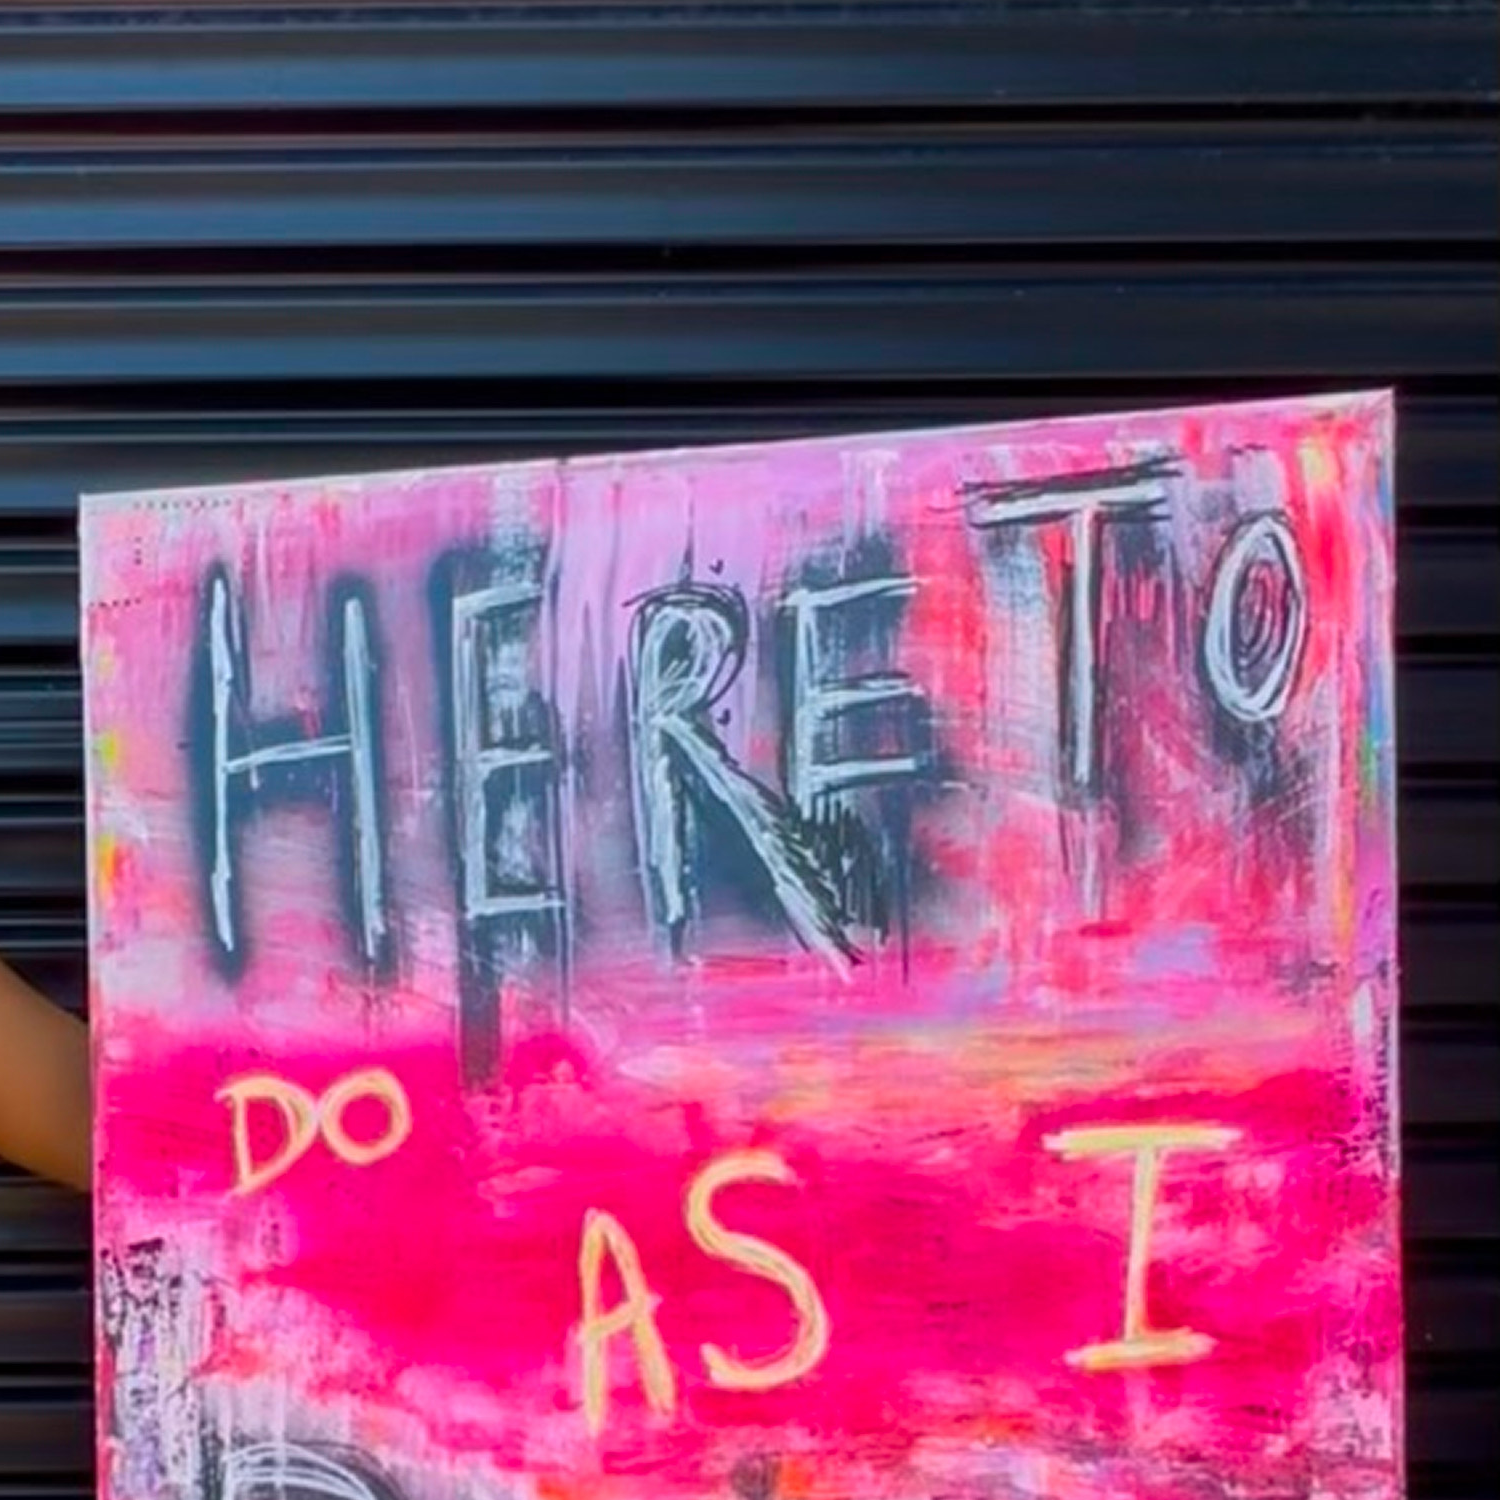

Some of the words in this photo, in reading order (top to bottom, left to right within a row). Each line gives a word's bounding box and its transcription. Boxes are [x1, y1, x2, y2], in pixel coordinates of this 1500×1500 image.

[202, 576, 924, 984] HERE
[962, 458, 1308, 790] TO
[218, 1066, 414, 1196] DO
[578, 1148, 832, 1436] AS
[1043, 1120, 1246, 1372] I
